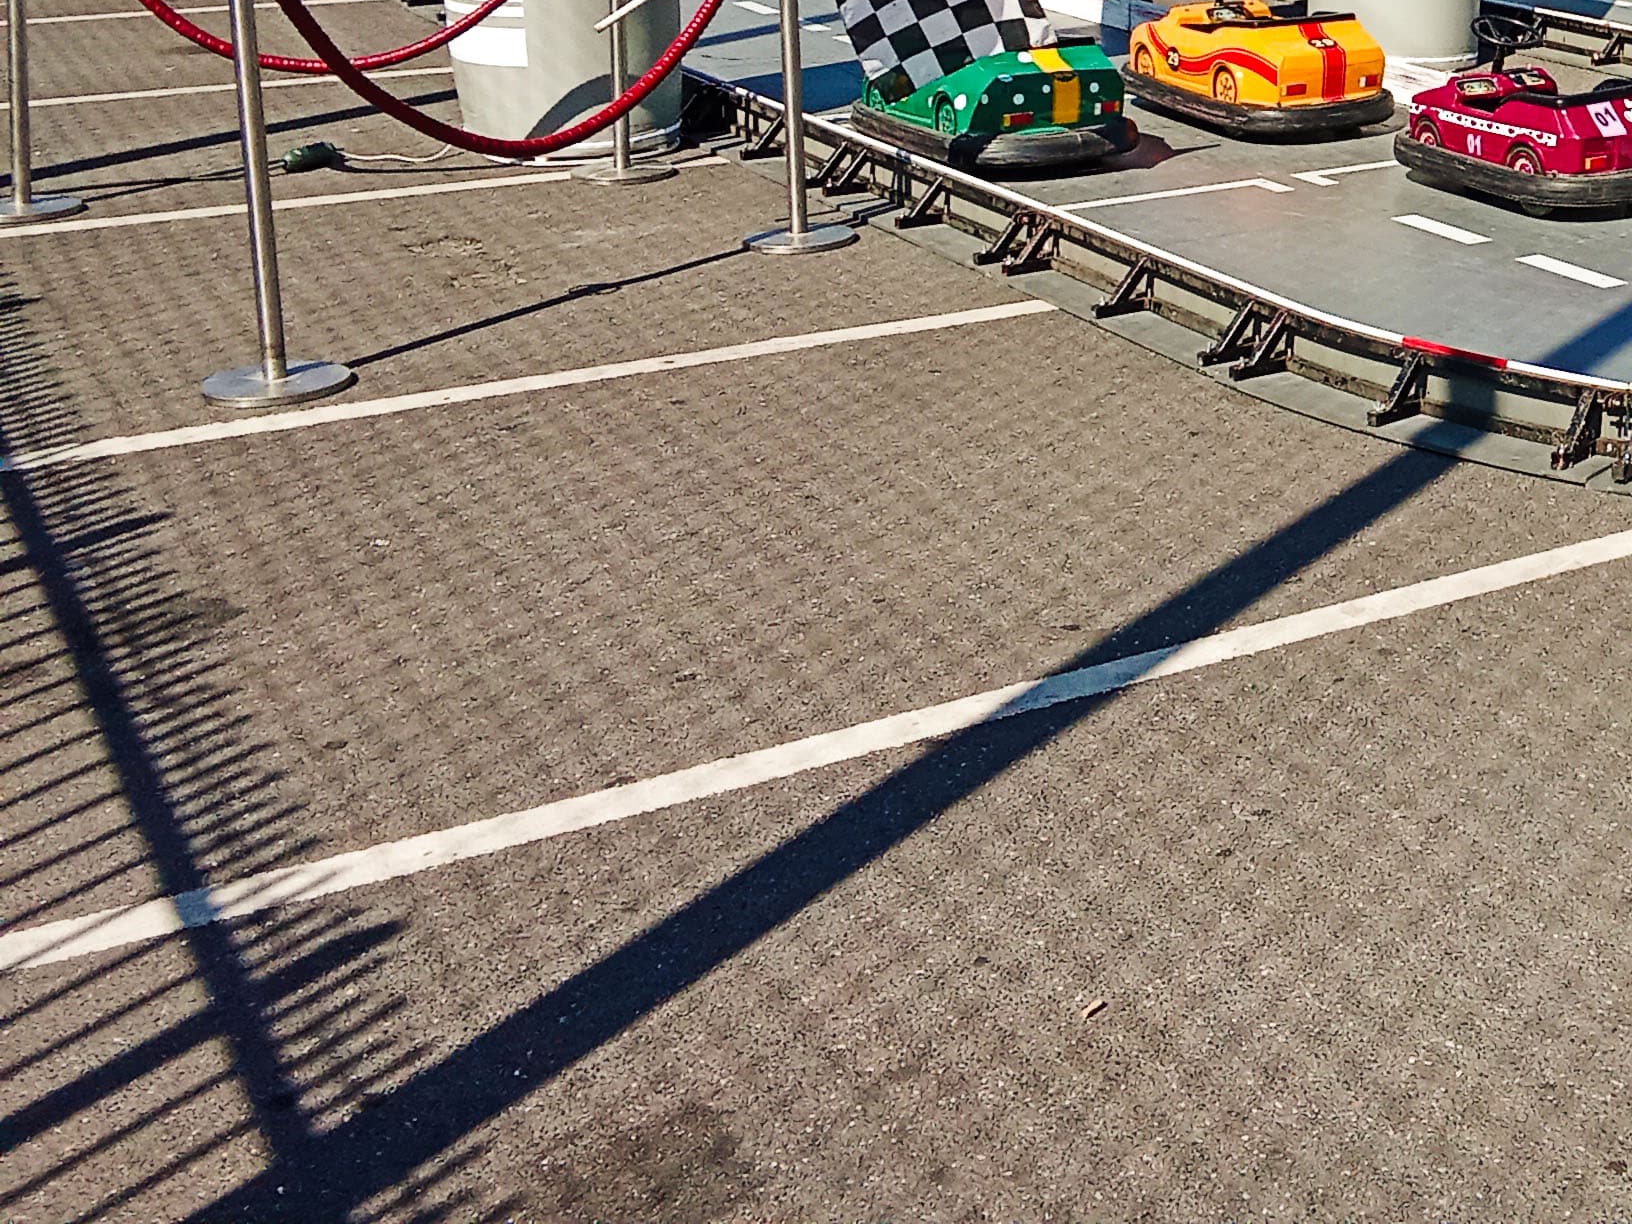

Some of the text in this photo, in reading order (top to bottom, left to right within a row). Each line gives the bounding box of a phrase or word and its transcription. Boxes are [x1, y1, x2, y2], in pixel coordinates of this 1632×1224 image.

[1167, 50, 1180, 67] 29
[1594, 107, 1617, 127] 01
[1466, 133, 1482, 156] 01
